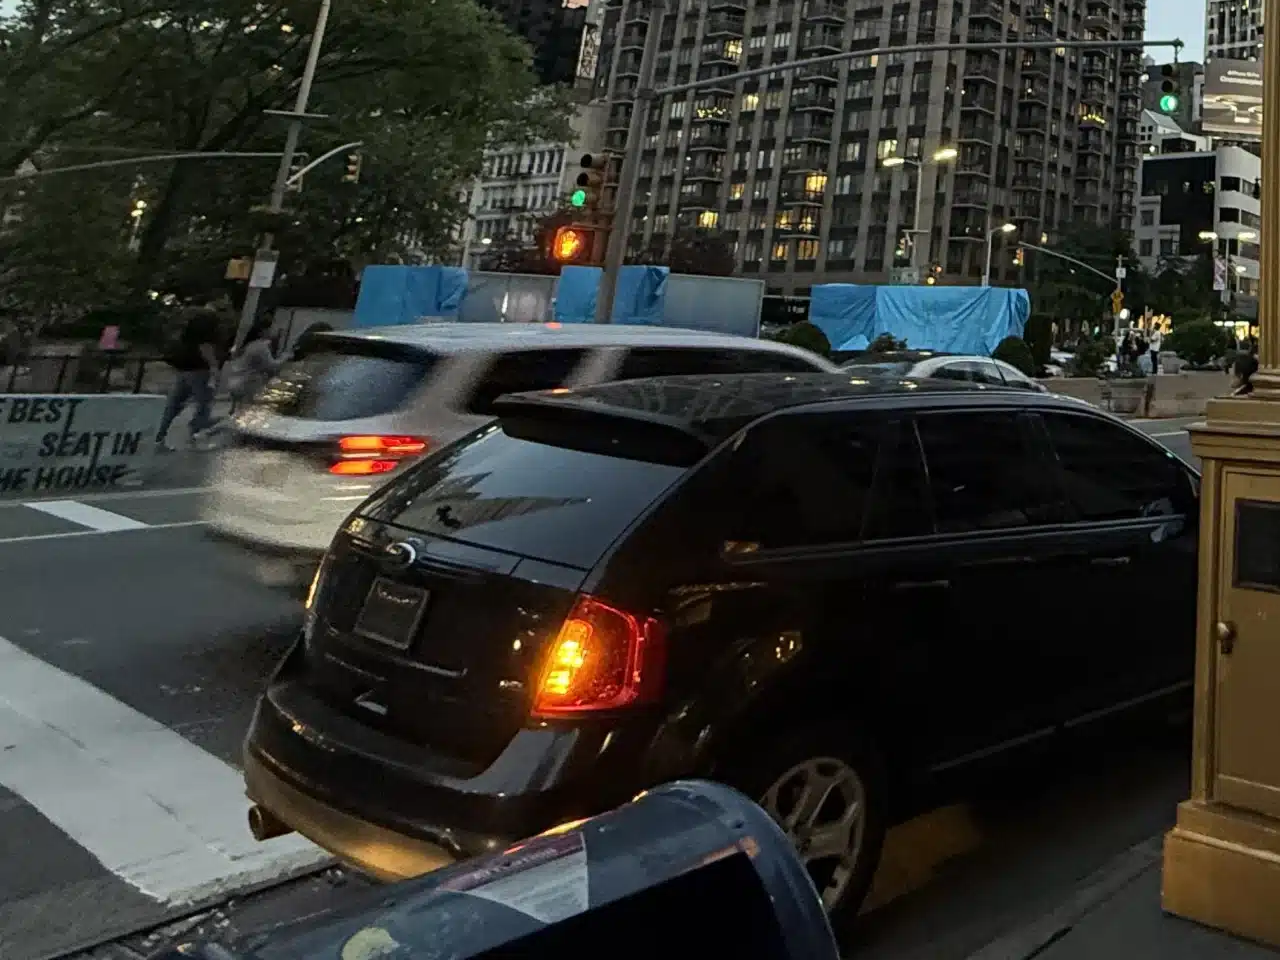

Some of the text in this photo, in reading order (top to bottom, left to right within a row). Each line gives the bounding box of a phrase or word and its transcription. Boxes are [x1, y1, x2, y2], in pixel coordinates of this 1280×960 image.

[7, 397, 84, 437] BEST
[38, 431, 142, 470] SEAT IN
